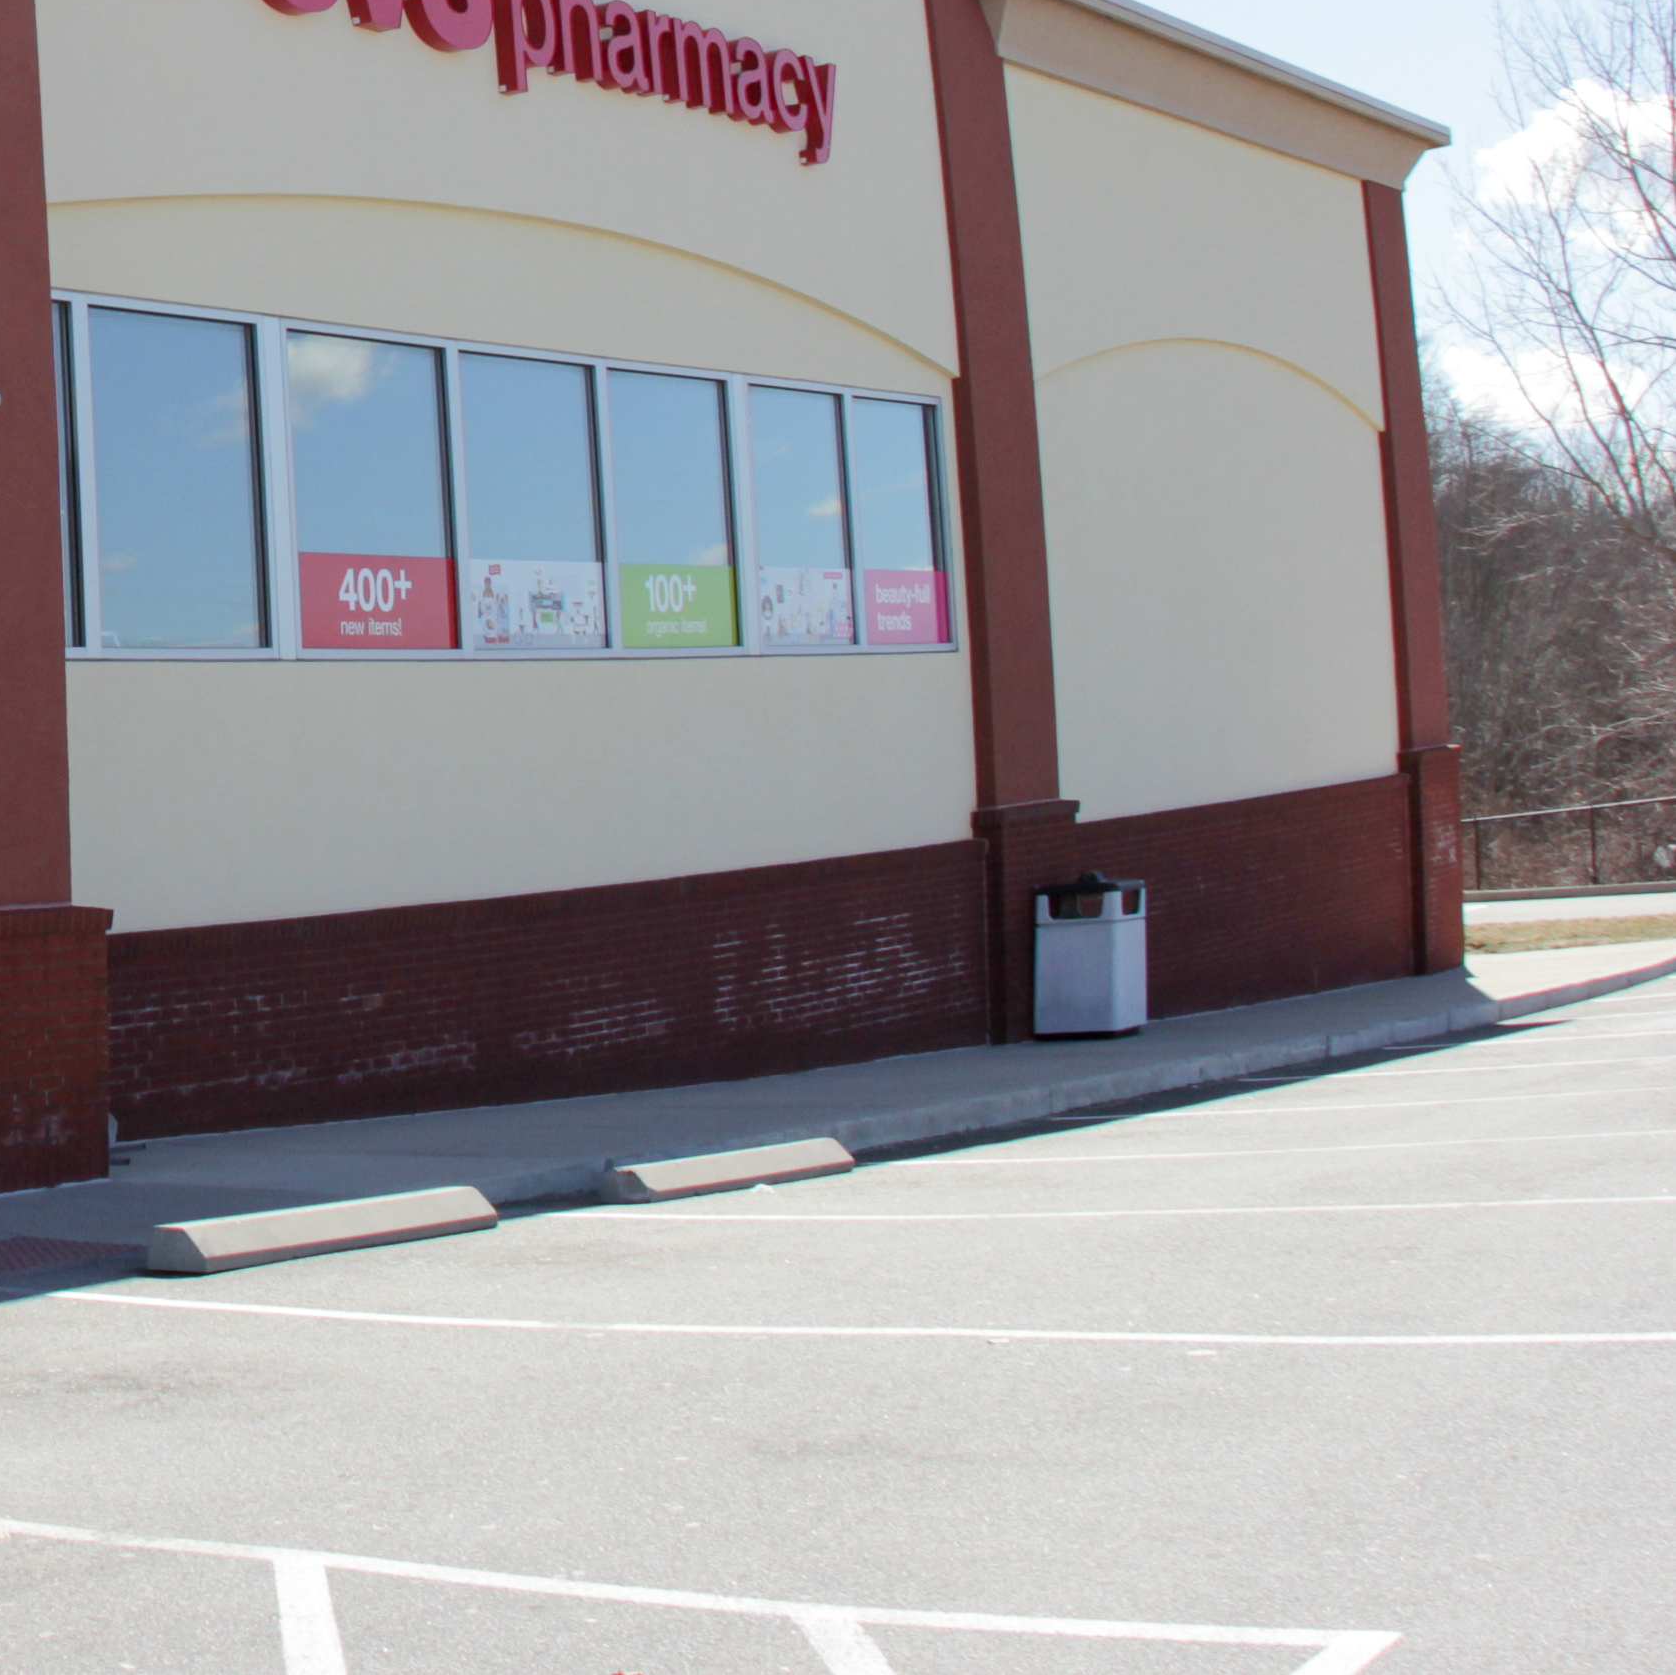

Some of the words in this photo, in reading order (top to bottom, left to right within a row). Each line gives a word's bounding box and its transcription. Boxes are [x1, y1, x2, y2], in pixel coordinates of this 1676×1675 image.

[338, 568, 412, 612] 400+
[644, 574, 697, 613] 100+
[340, 621, 365, 635] new
[368, 617, 402, 636] items!
[877, 612, 912, 631] trends
